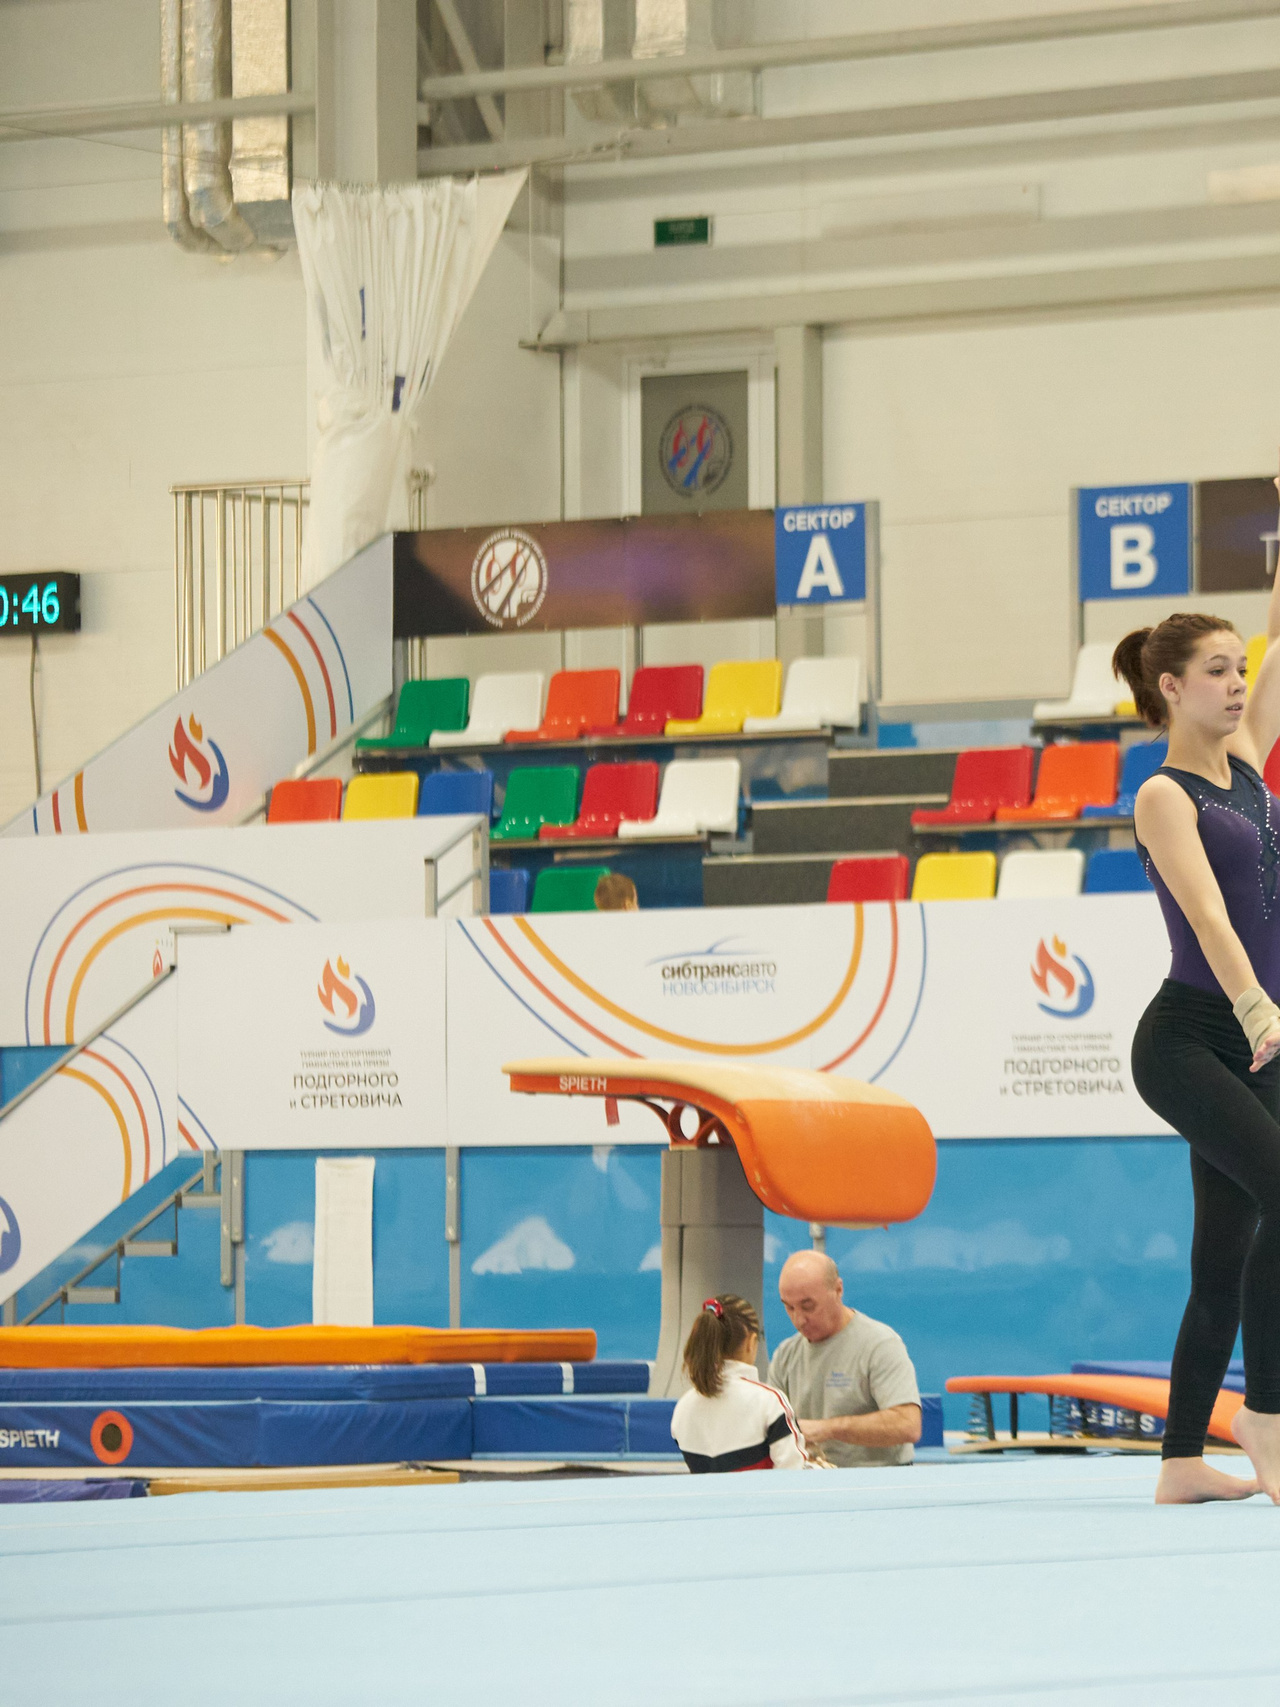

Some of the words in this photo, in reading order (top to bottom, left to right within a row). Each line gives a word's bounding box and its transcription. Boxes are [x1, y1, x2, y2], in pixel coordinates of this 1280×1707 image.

[1094, 492, 1172, 518] СЕКТОР
[783, 507, 856, 532] СЕКТОР
[661, 960, 777, 983] сибтрансавто
[662, 979, 776, 996] НОВОСИБИРСК
[1003, 1057, 1121, 1076] ПОДГОРНОГО
[293, 1072, 399, 1091] ПОДГОРНОГО
[559, 1074, 607, 1092] SPIETH
[1011, 1078, 1125, 1097] СТРЕТОВИЧА
[289, 1097, 297, 1110] и
[301, 1093, 403, 1110] СТРЕТОВИЧА
[0, 1428, 61, 1448] SPIETH
